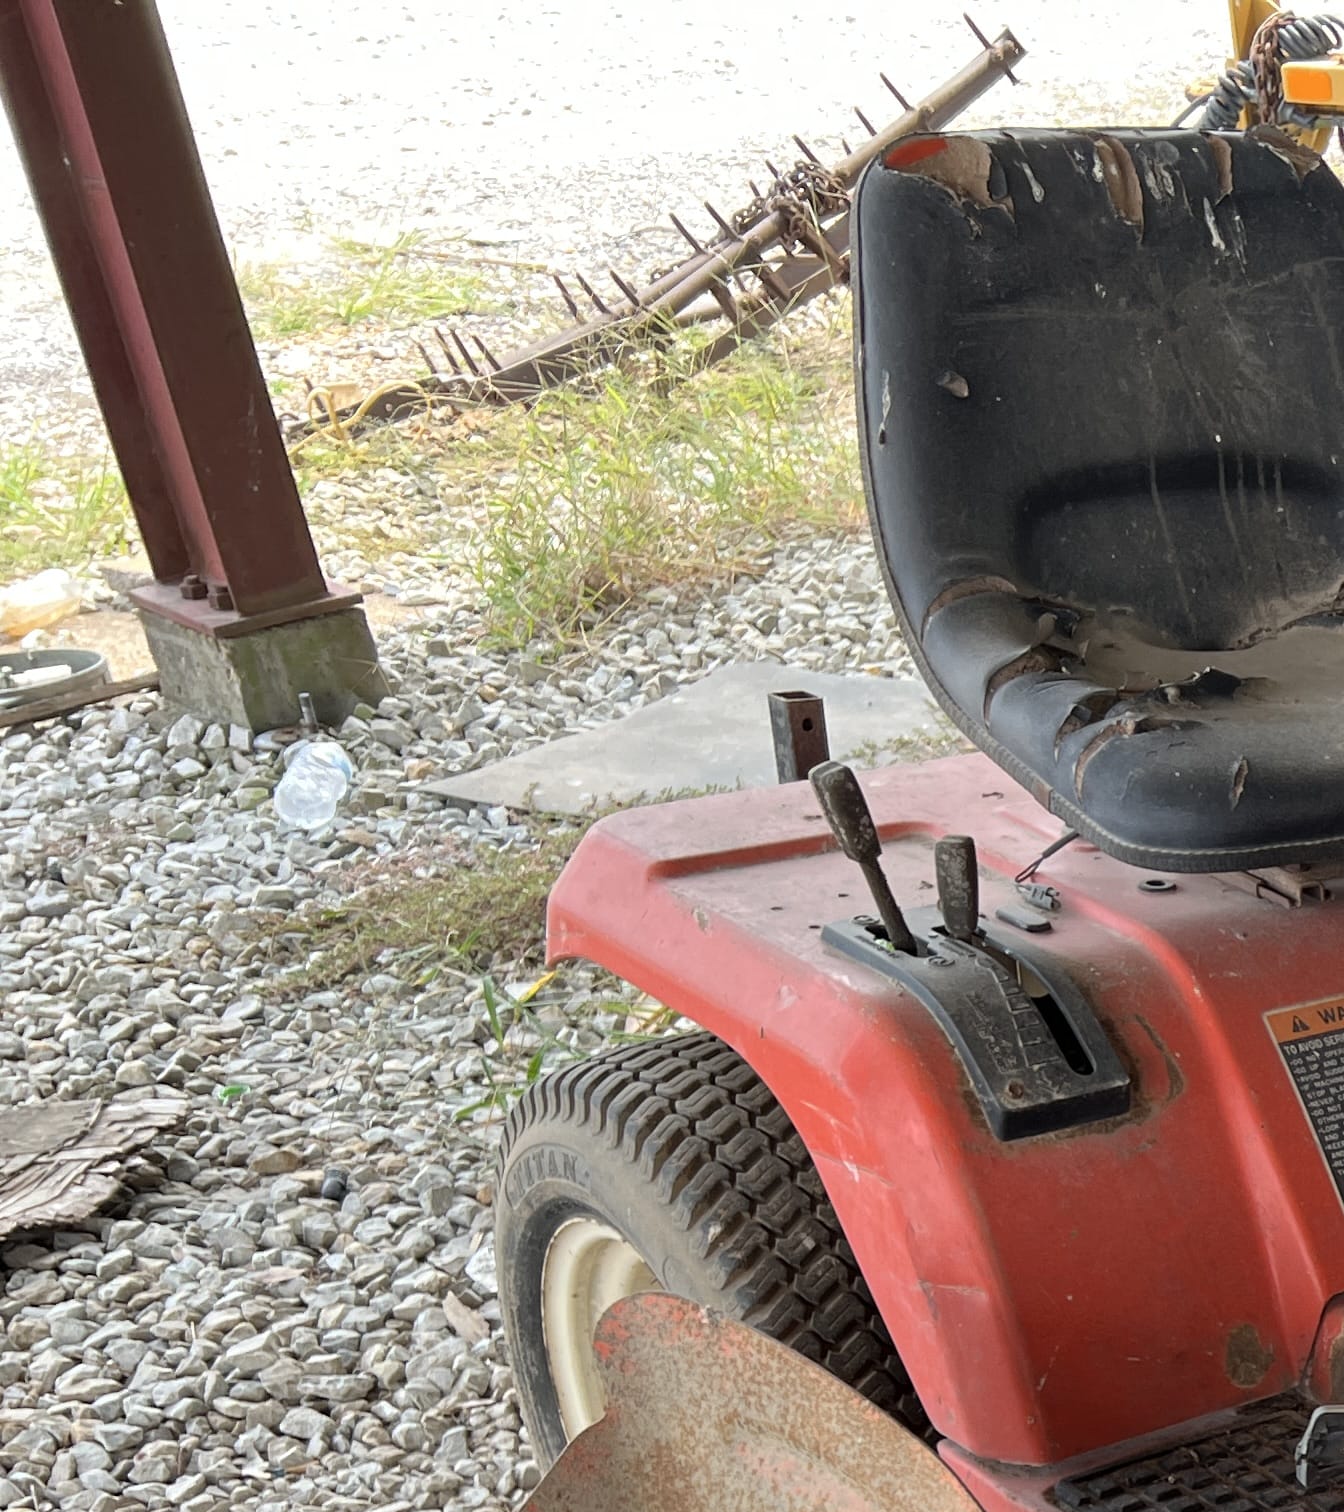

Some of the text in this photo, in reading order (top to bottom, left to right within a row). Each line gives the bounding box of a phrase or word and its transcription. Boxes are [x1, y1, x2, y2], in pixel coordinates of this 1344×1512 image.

[1283, 1044, 1297, 1054] TO
[1298, 1039, 1323, 1052] AVOID
[1300, 1072, 1320, 1082] AVOID
[1314, 1076, 1344, 1087] MACHINE
[1327, 1103, 1341, 1112] NOT
